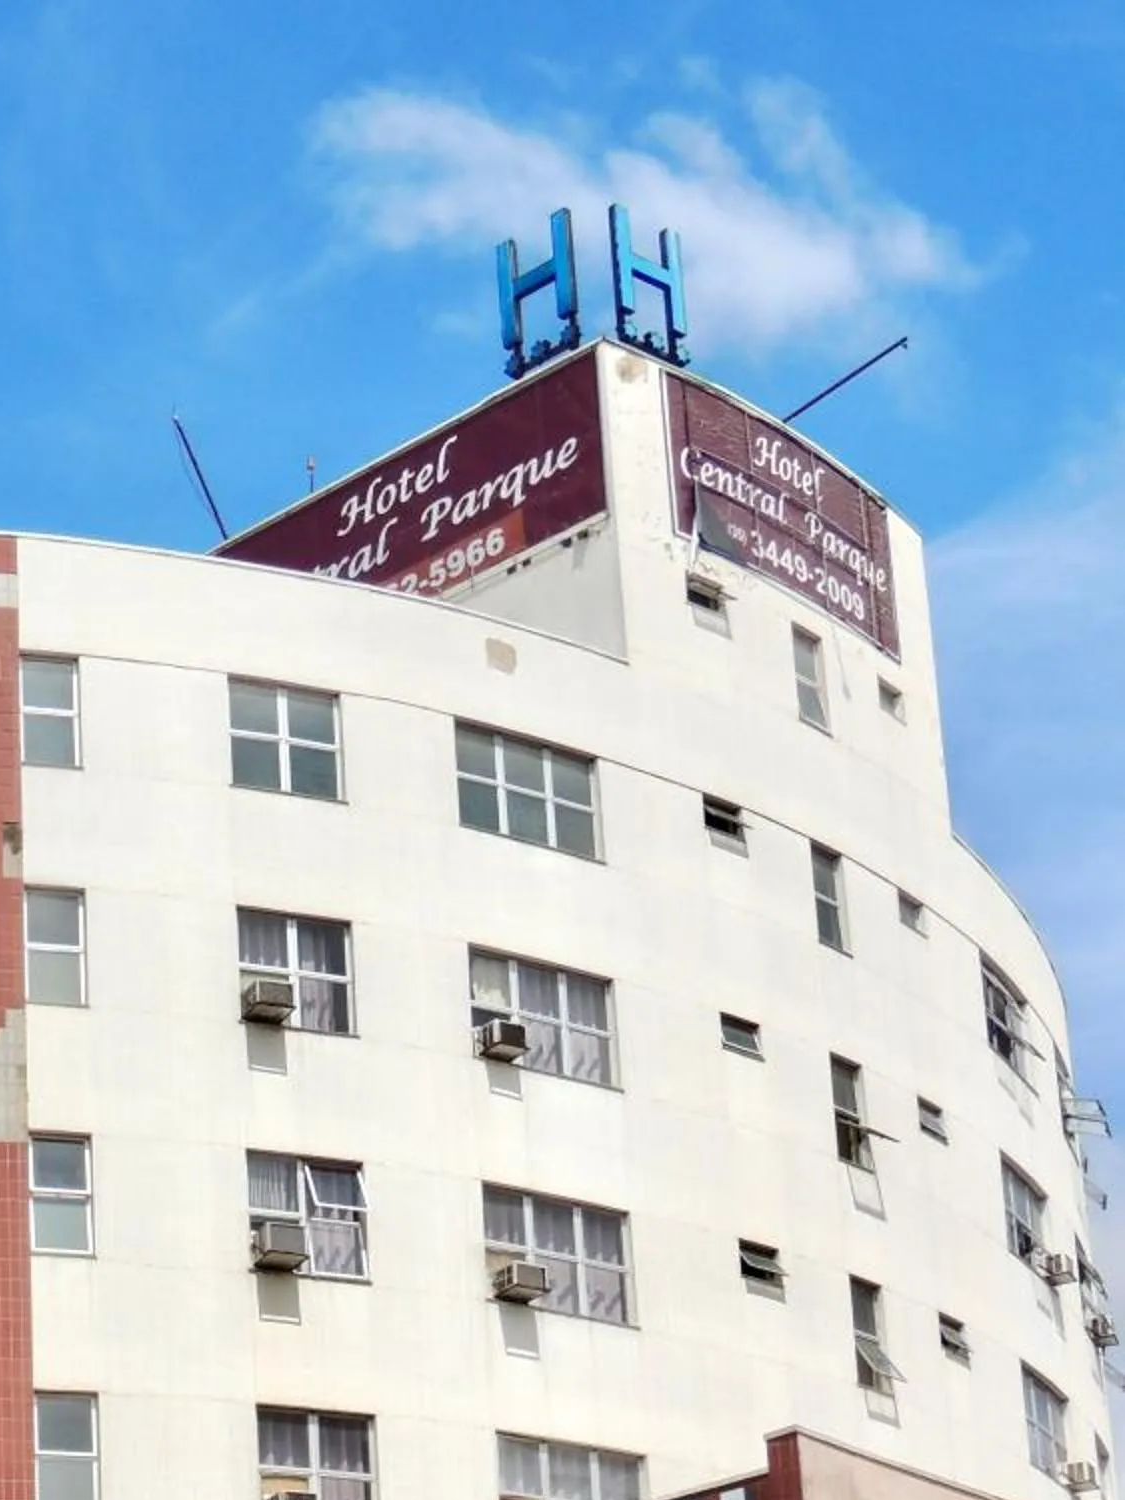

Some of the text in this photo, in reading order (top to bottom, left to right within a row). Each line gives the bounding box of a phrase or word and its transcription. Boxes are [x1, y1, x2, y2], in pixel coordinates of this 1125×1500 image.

[496, 207, 576, 350] H
[609, 204, 687, 337] H
[336, 435, 458, 537] Hotel
[419, 436, 579, 542] Parque
[680, 446, 888, 592] Central Parque
[754, 436, 825, 501] Hotel
[383, 527, 505, 595] 2-5966
[750, 529, 865, 621] 3449-2009
